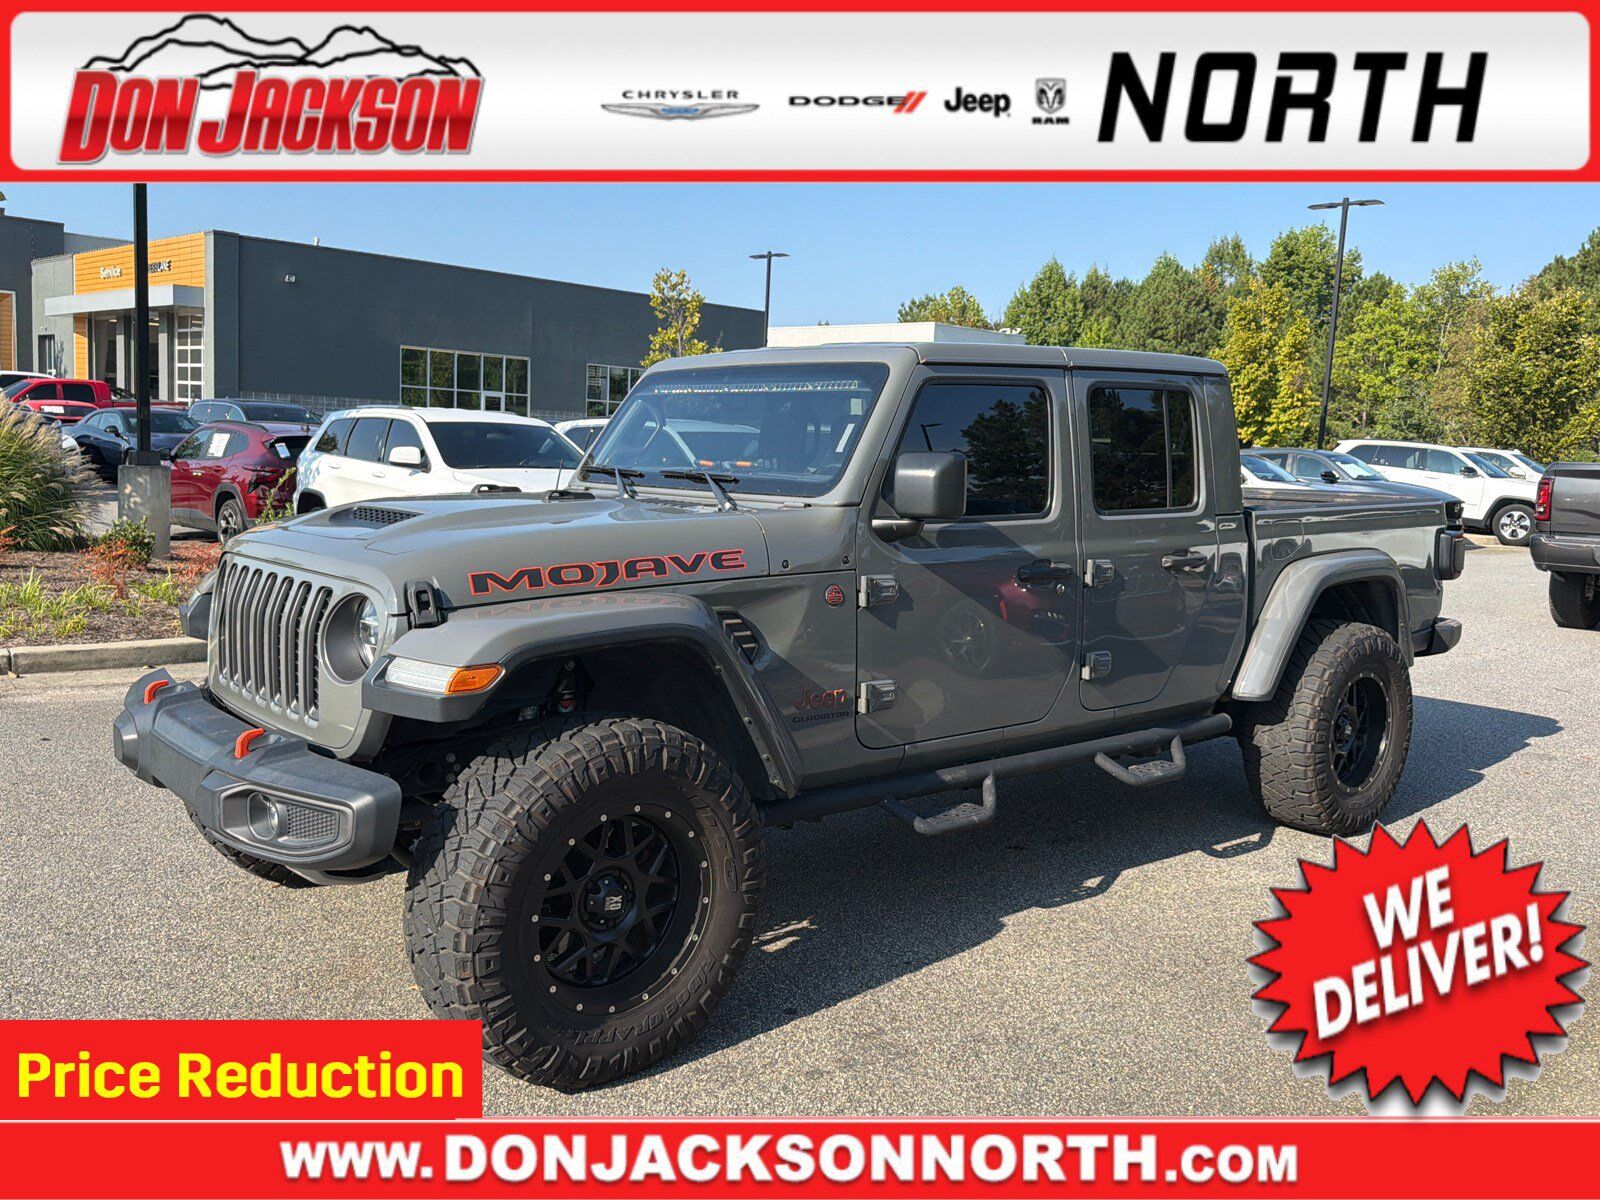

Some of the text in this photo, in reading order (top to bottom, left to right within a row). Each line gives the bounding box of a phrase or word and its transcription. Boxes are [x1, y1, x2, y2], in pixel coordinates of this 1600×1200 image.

[467, 549, 747, 596] MOJAVE
[793, 687, 848, 711] Jeep
[792, 711, 850, 723] GLADIATOR
